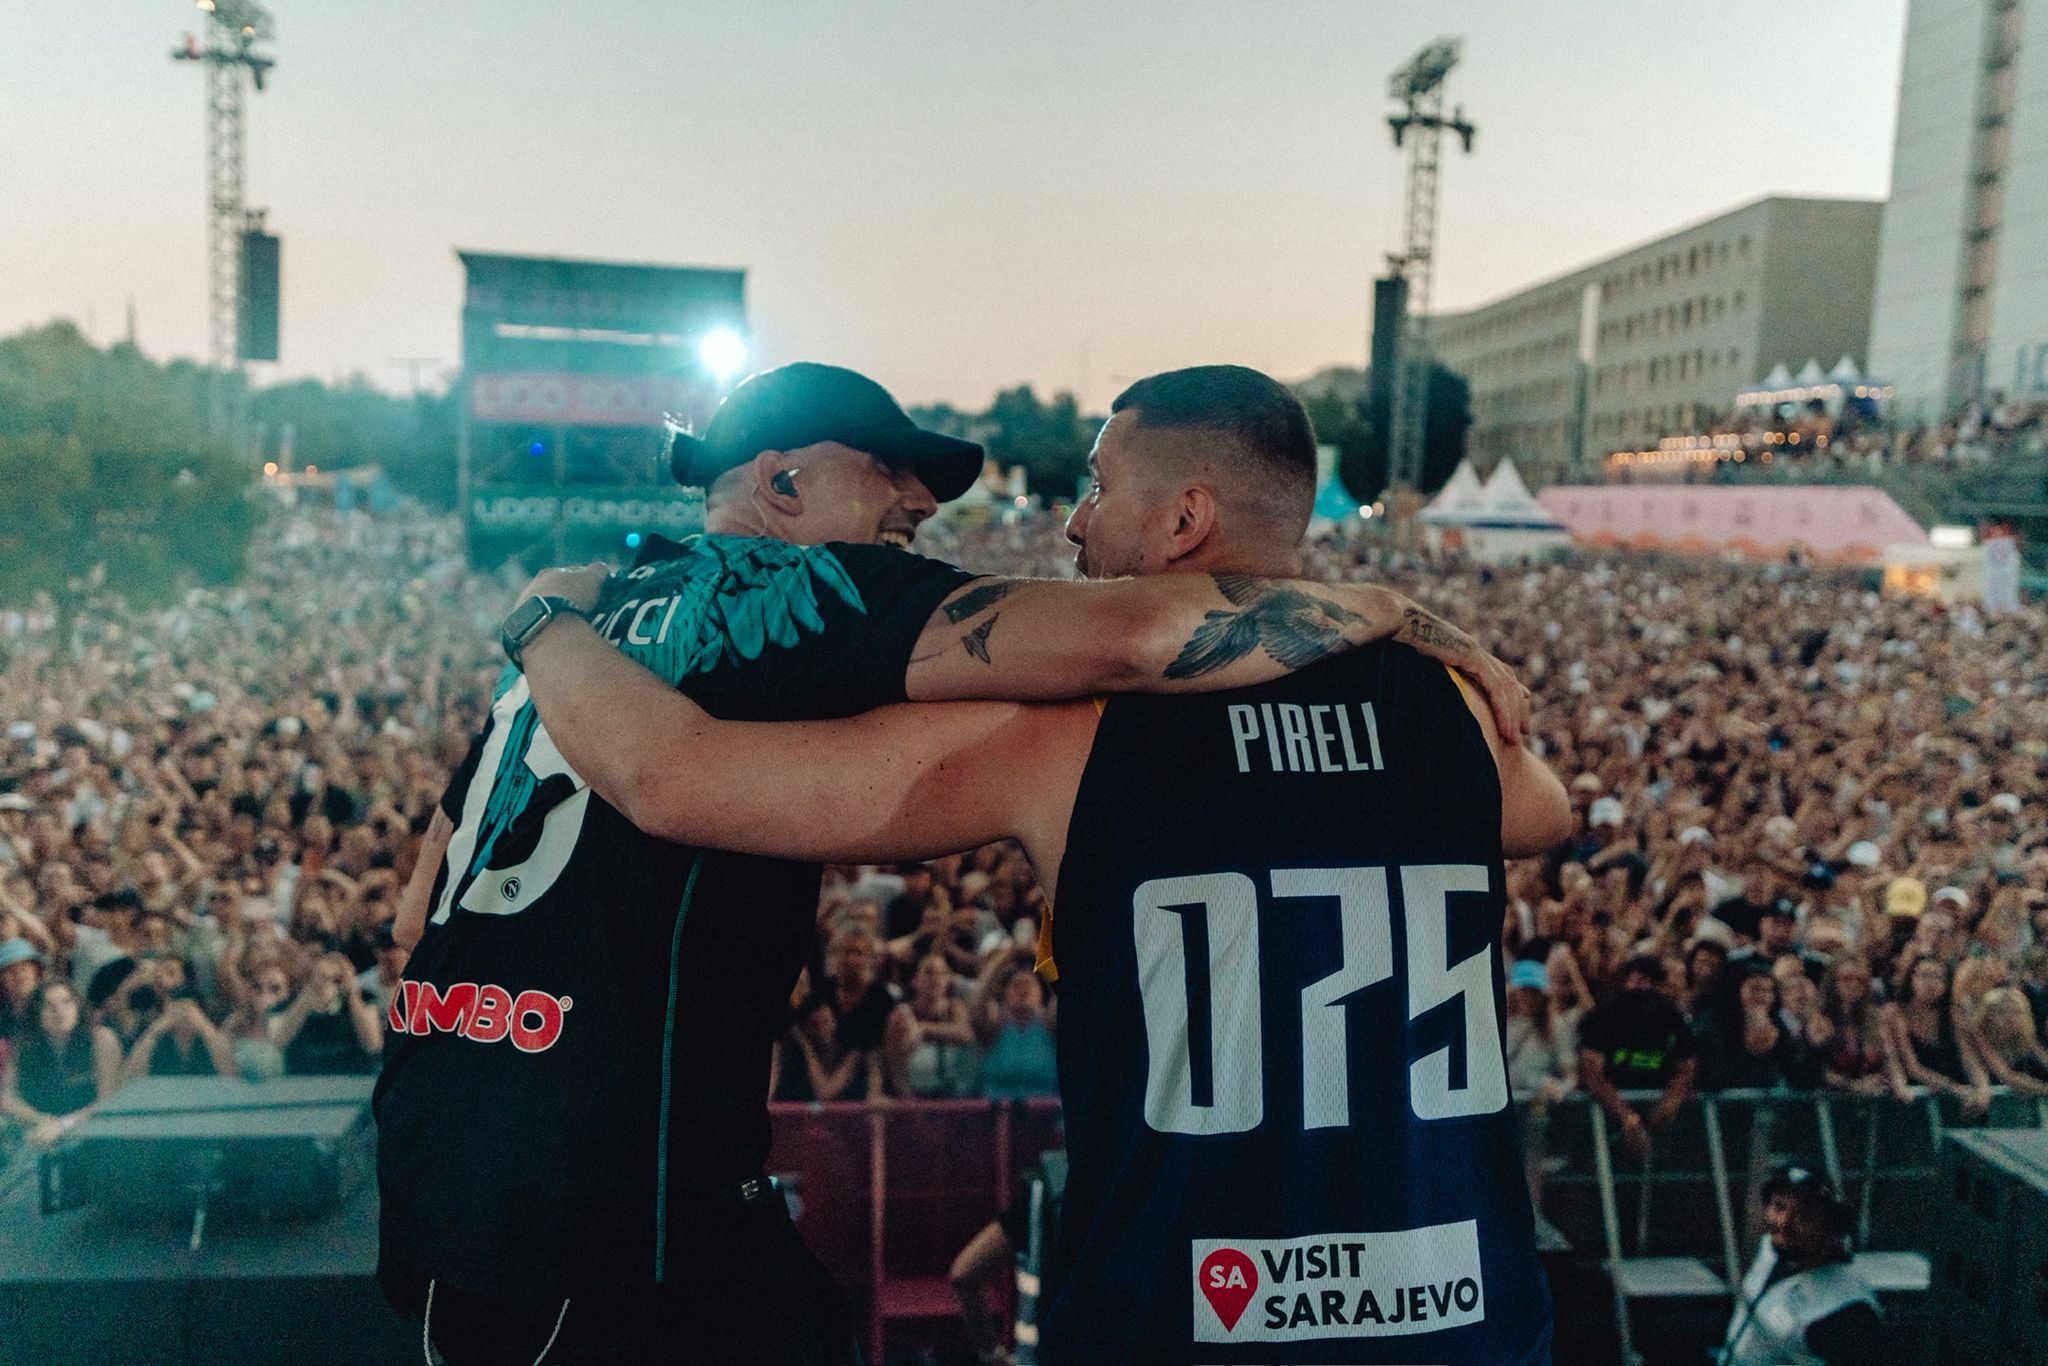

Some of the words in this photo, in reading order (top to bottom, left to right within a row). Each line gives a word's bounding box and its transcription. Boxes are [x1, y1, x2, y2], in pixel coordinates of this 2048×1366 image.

[1227, 702, 1384, 773] PIRELI
[1132, 864, 1508, 1136] 075
[1208, 1265, 1248, 1289] SA
[1261, 1243, 1366, 1284] VISIT
[1264, 1277, 1479, 1330] SARAJEVO
